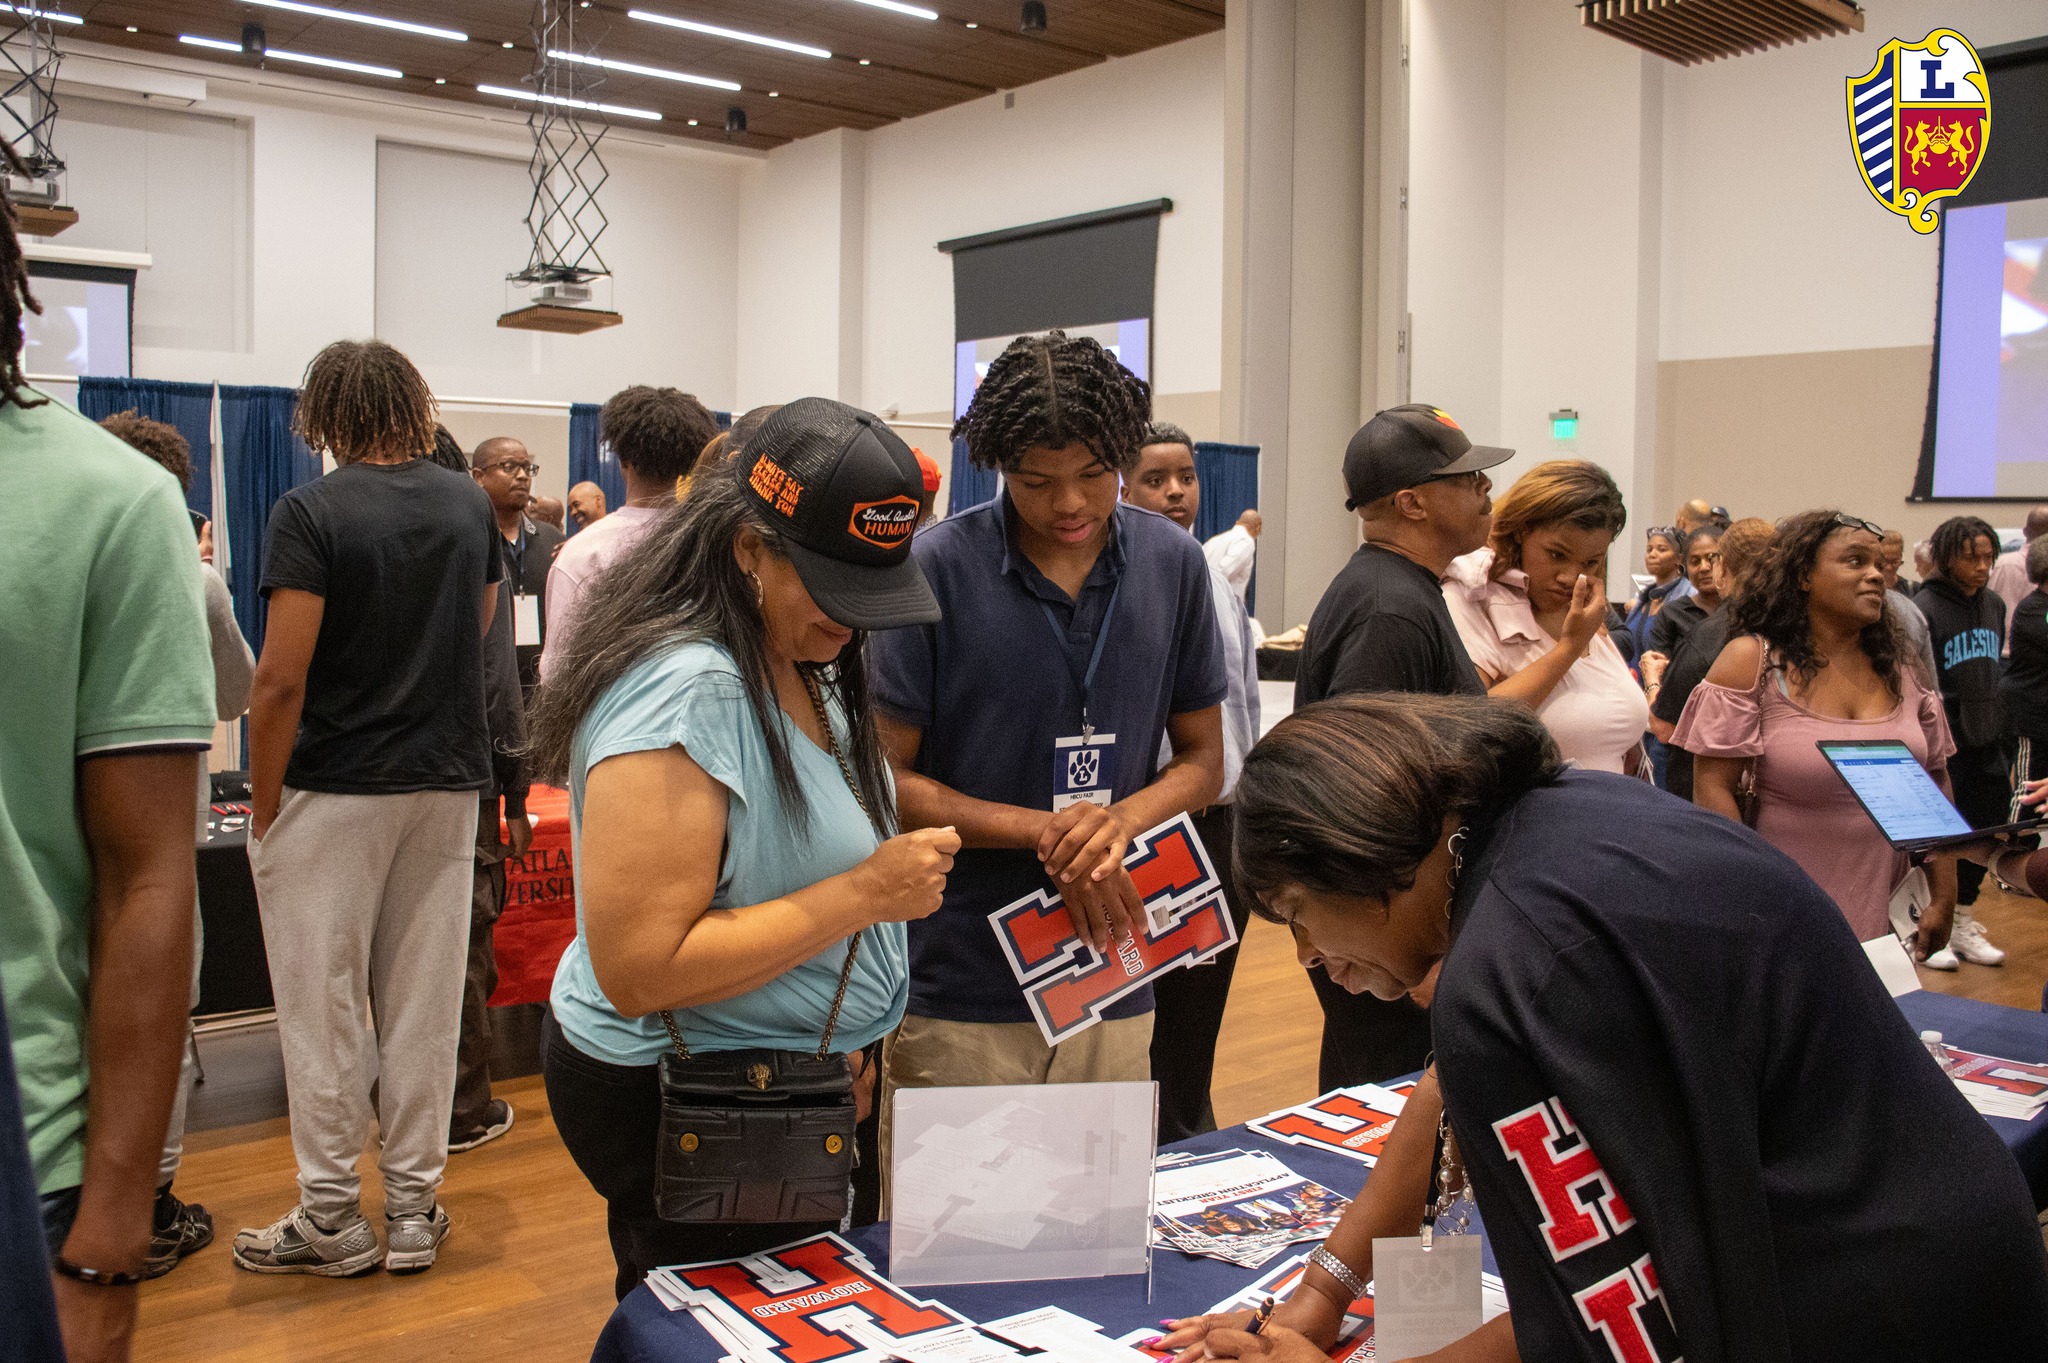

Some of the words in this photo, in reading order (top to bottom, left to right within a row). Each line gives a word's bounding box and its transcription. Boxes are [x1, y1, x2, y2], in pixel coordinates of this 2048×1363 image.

[752, 461, 781, 493] PLEASE
[780, 488, 799, 506] AND
[760, 453, 787, 482] ALWAYS
[785, 477, 804, 496] SAY
[749, 475, 775, 503] THANK
[775, 496, 795, 518] YOU
[864, 520, 912, 536] HUMAN
[1079, 770, 1088, 782] L
[1218, 1172, 1290, 1194] APPLICATION
[1233, 1186, 1264, 1197] FIRST
[1157, 1191, 1218, 1206] CHECKLIST
[1200, 1195, 1231, 1203] YEAR
[752, 1281, 873, 1318] HOWARD
